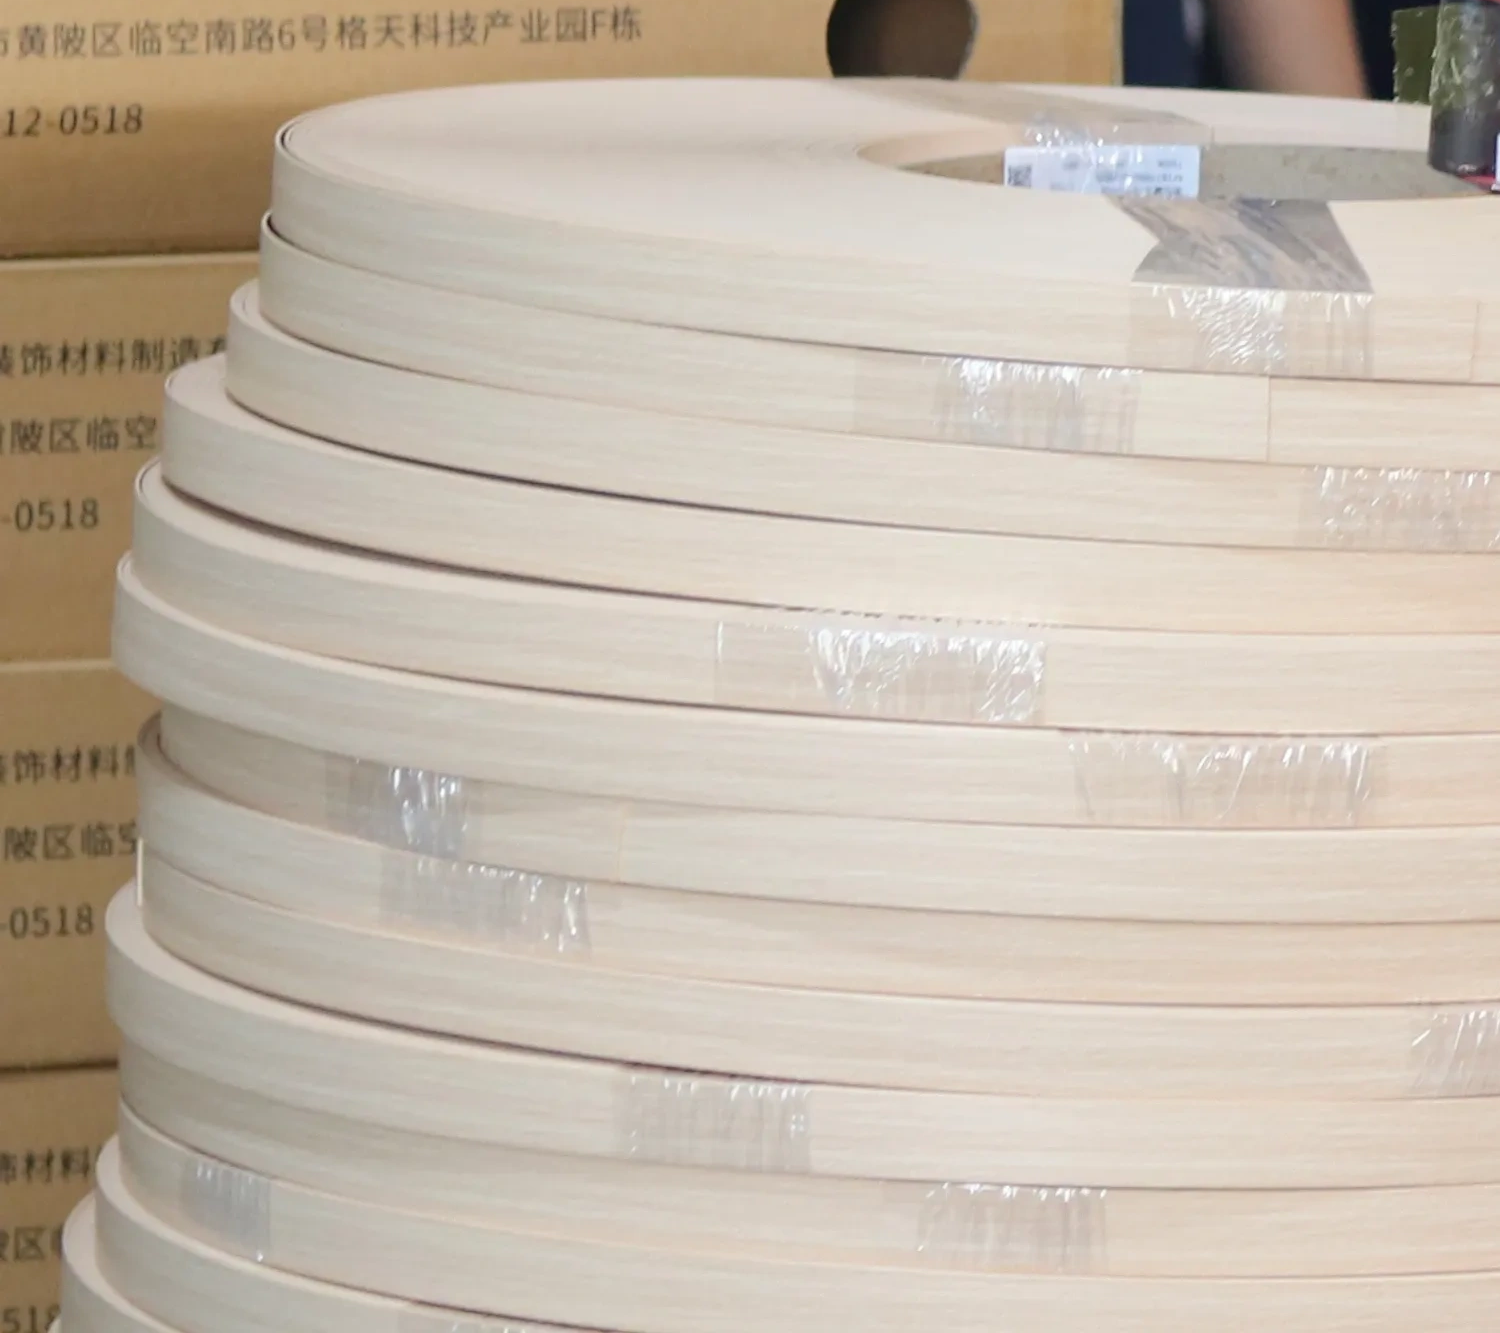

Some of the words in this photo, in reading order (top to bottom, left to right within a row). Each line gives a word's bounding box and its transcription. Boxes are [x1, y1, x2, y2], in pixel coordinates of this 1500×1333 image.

[0, 2, 642, 60] 黄陂区临空南路6号格天科技产业园F栋
[0, 415, 157, 455] 陂区临空
